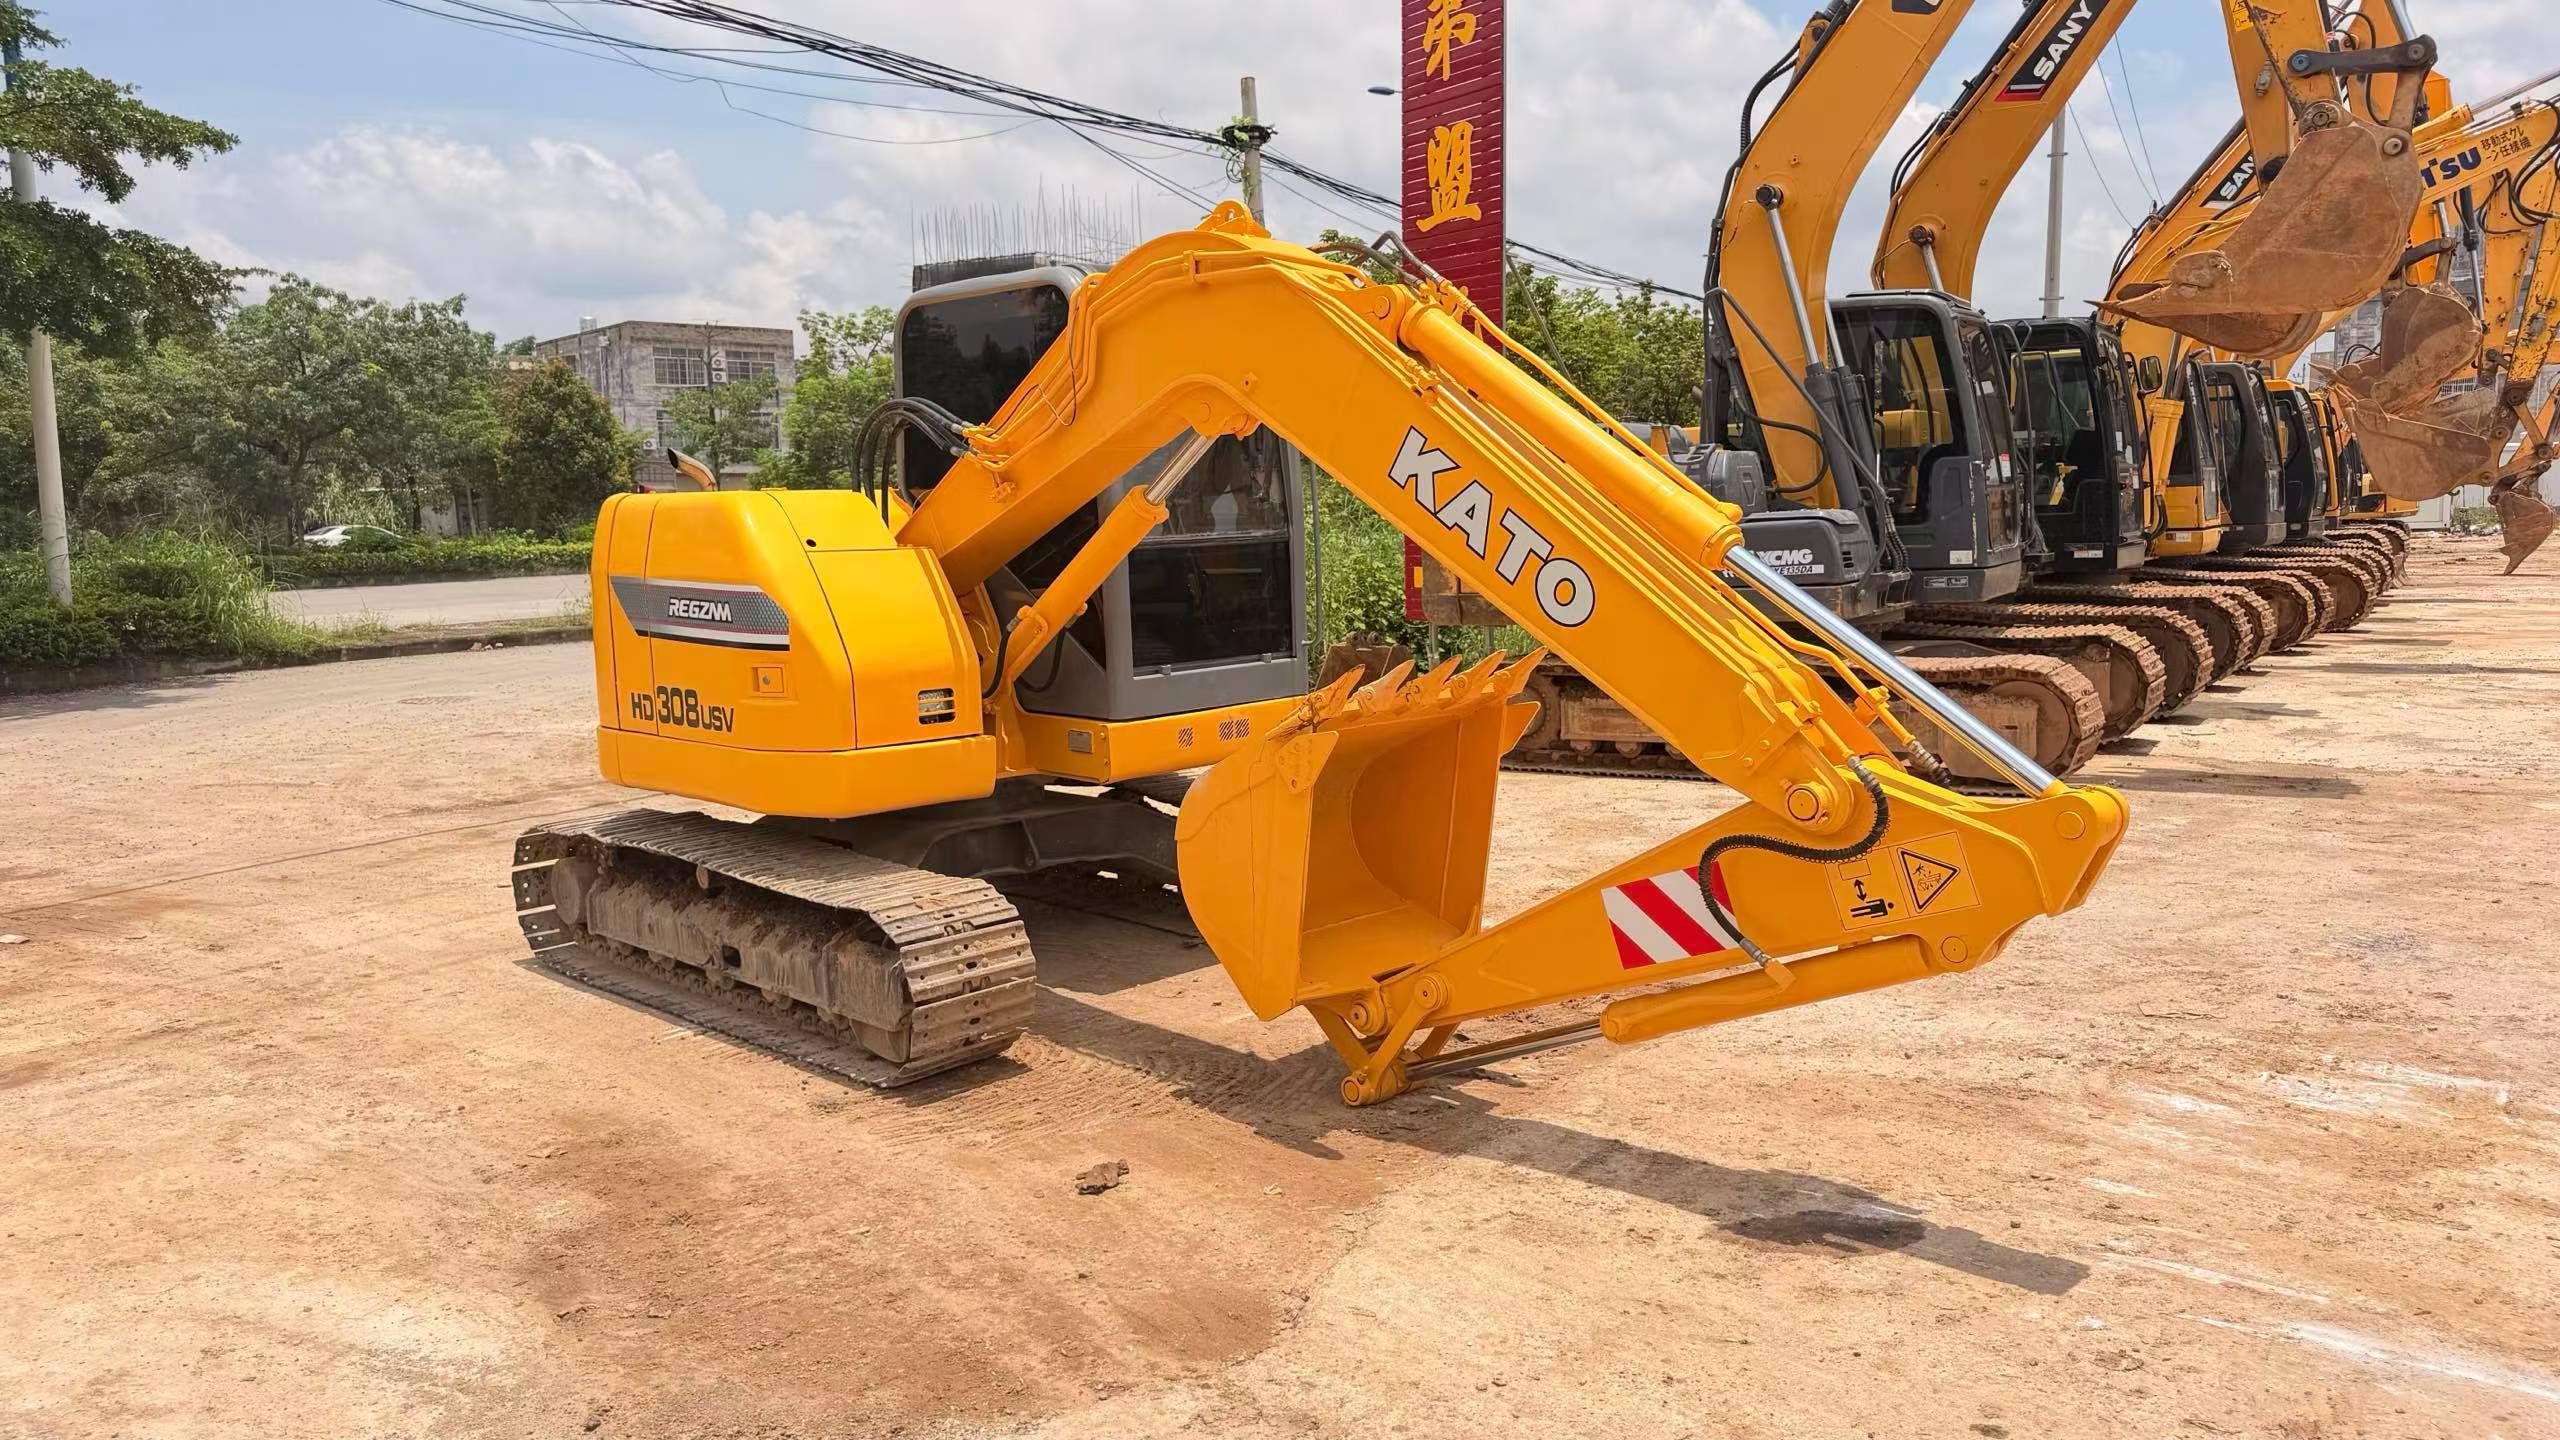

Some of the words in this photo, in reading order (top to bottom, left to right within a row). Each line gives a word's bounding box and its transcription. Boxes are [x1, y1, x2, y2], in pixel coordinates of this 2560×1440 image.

[2033, 0, 2093, 81] SANY
[1388, 425, 1596, 628] KATO
[1755, 548, 1813, 566] XCMG
